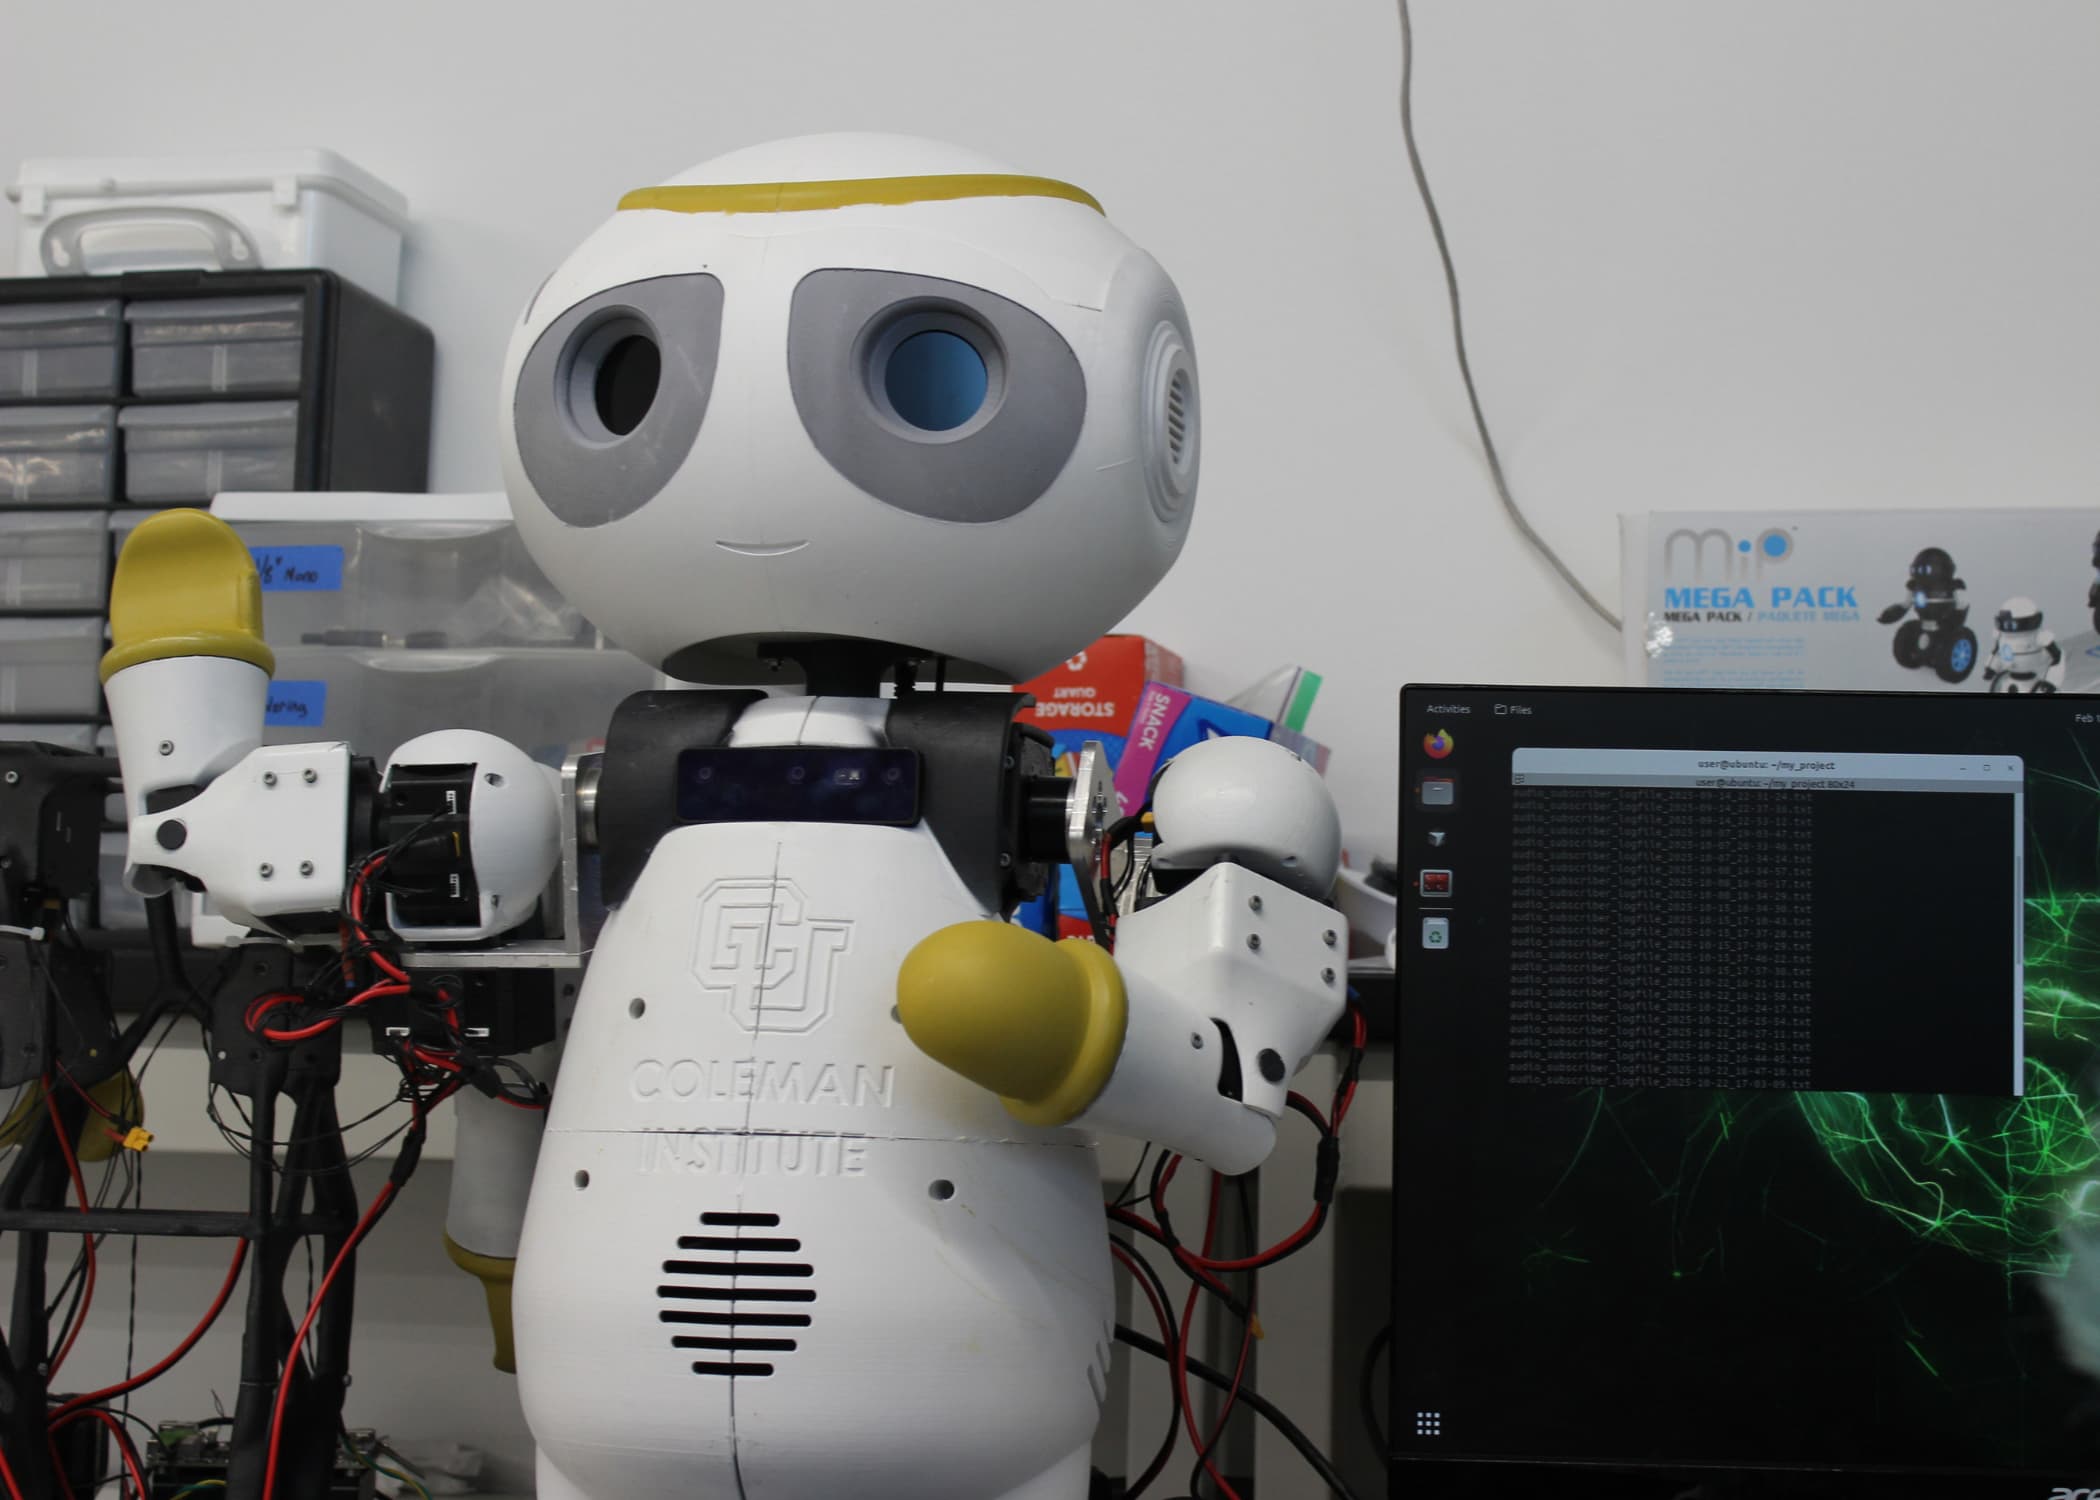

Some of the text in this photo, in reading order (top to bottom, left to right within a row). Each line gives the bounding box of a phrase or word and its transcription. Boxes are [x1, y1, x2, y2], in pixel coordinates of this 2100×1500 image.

[1664, 585, 1858, 609] MEGA PACK
[1663, 610, 1701, 622] MEGA
[1706, 611, 1742, 623] PACK
[1053, 687, 1097, 699] QUART
[1035, 702, 1115, 718] STORAGE
[1427, 705, 1471, 714] Activities
[1510, 705, 1533, 715] Files
[2074, 713, 2095, 723] Feb
[1138, 693, 1171, 751] SNACK
[1698, 759, 1836, 772] user@ubuntu: ~/my_project
[631, 1058, 896, 1109] COLEMAN
[637, 1126, 868, 1177] INSTITUTE
